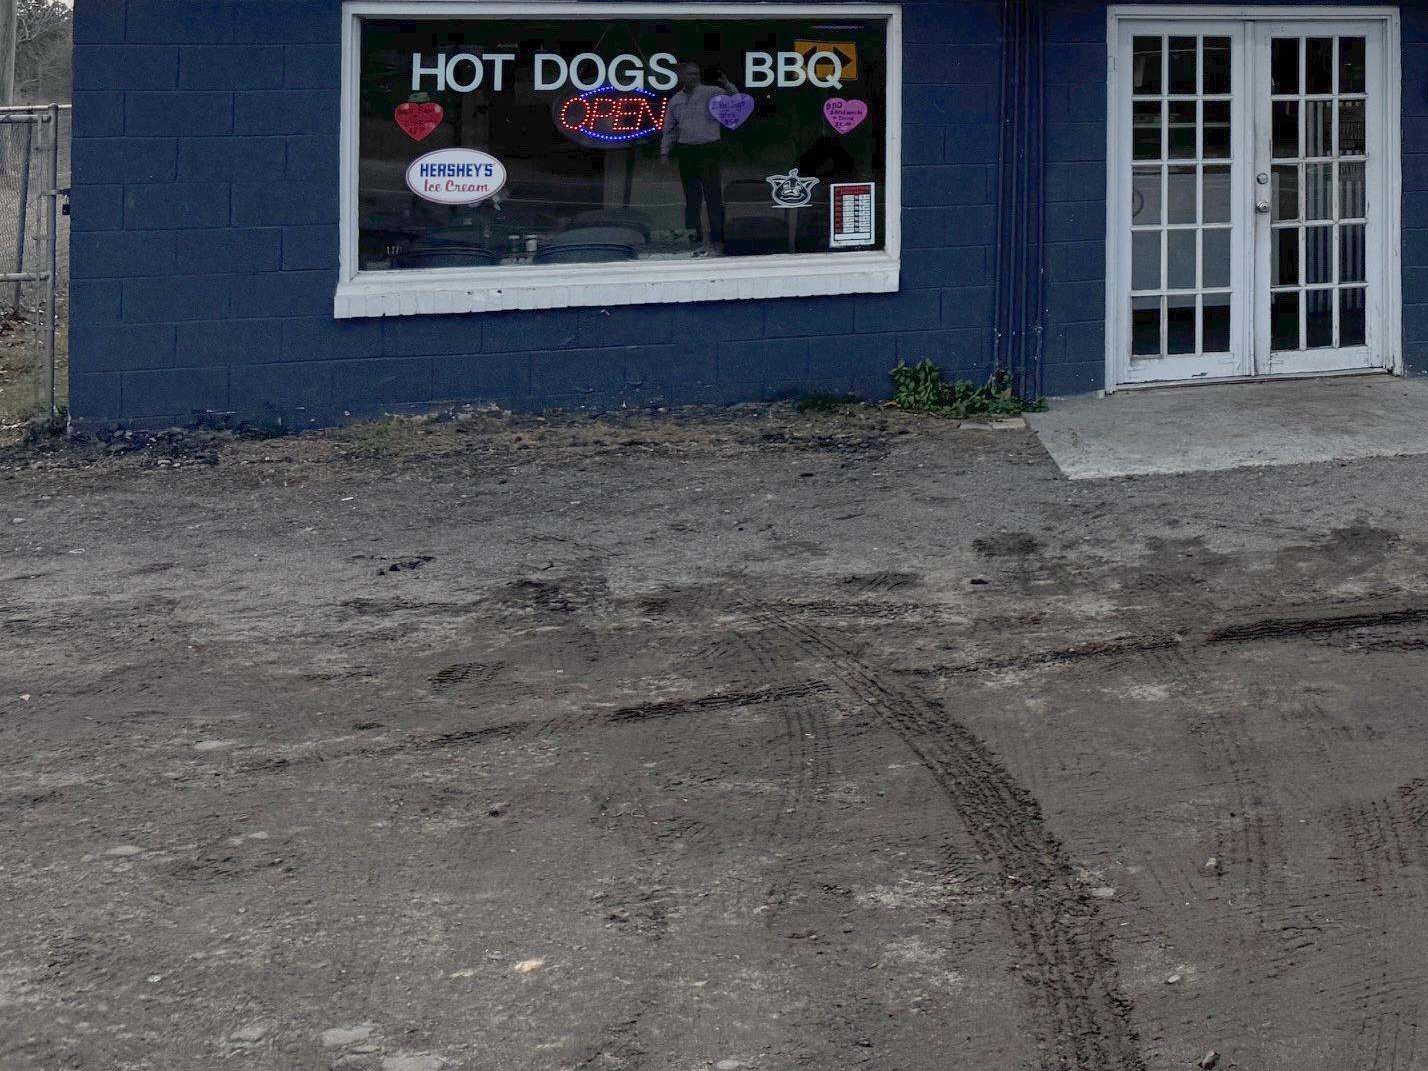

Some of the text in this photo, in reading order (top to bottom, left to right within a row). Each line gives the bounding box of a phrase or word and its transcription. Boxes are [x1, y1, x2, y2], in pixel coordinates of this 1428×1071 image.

[412, 52, 679, 91] HOT DOGS
[744, 51, 843, 90] BBQ
[560, 97, 667, 131] OPEN
[420, 163, 494, 178] HERSHEY'S
[424, 179, 488, 192] Ice Cream
